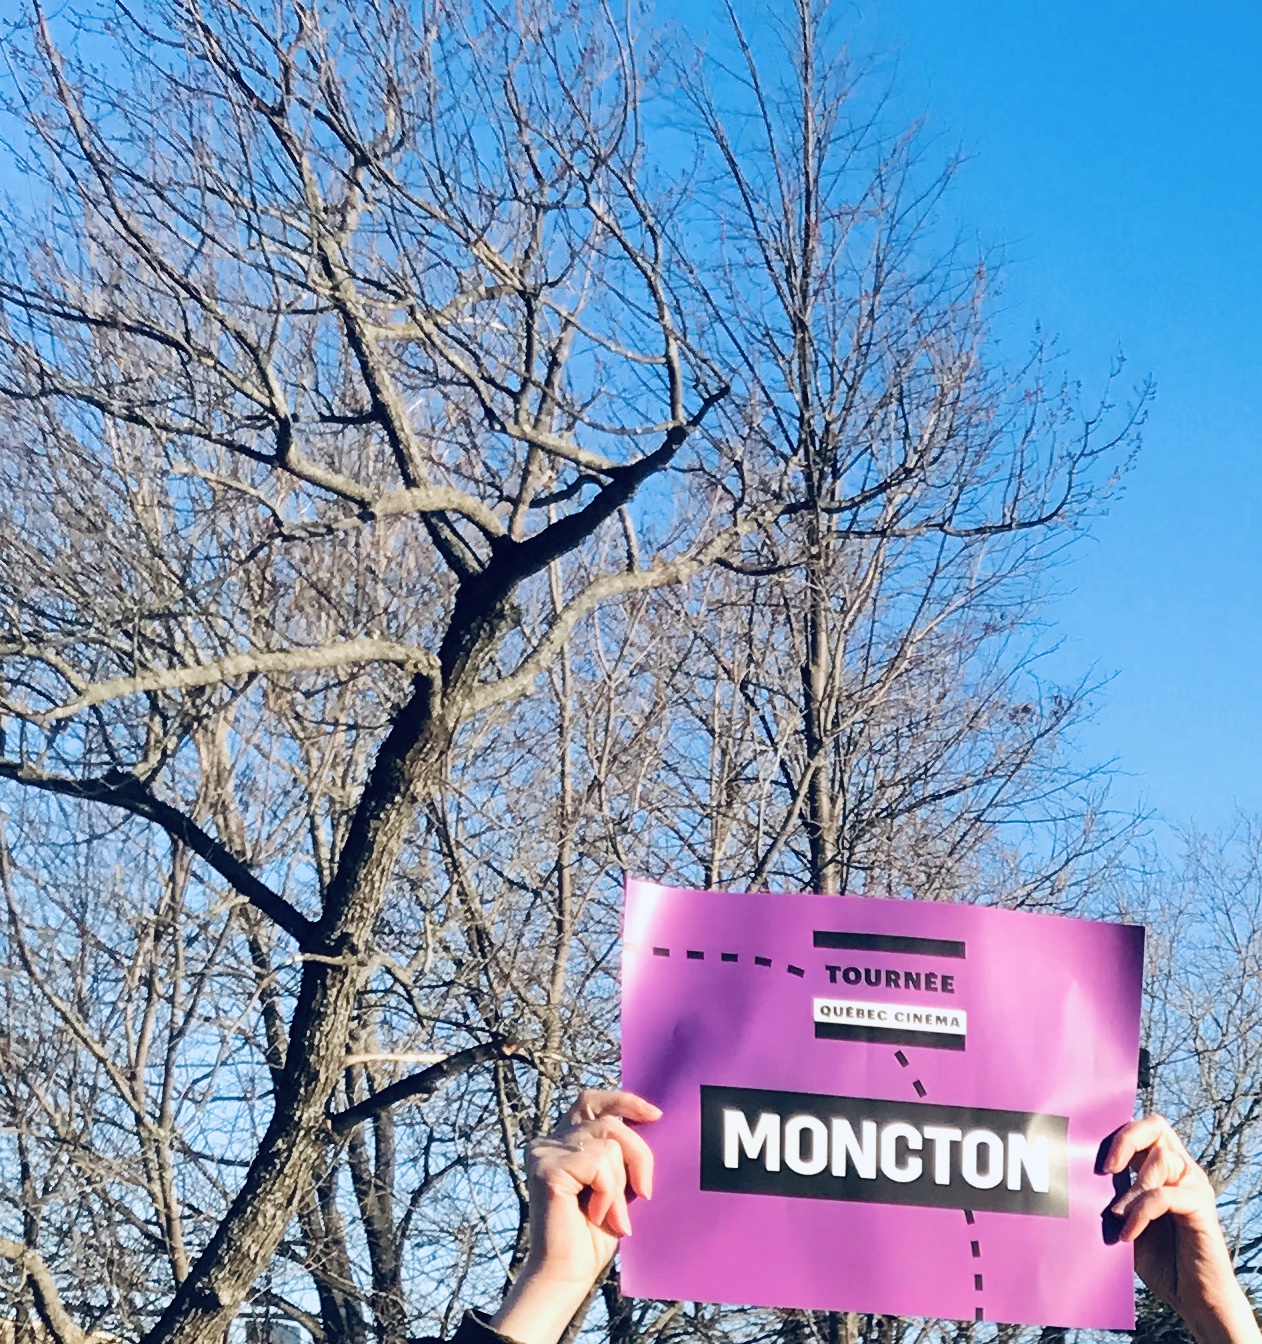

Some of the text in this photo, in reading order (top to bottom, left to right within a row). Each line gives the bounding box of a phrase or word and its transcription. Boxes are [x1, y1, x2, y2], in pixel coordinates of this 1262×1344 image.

[825, 964, 955, 993] TOURNÉE
[820, 1004, 960, 1028] QUÉBEC CINÉMA
[722, 1108, 1050, 1193] MONCTON
